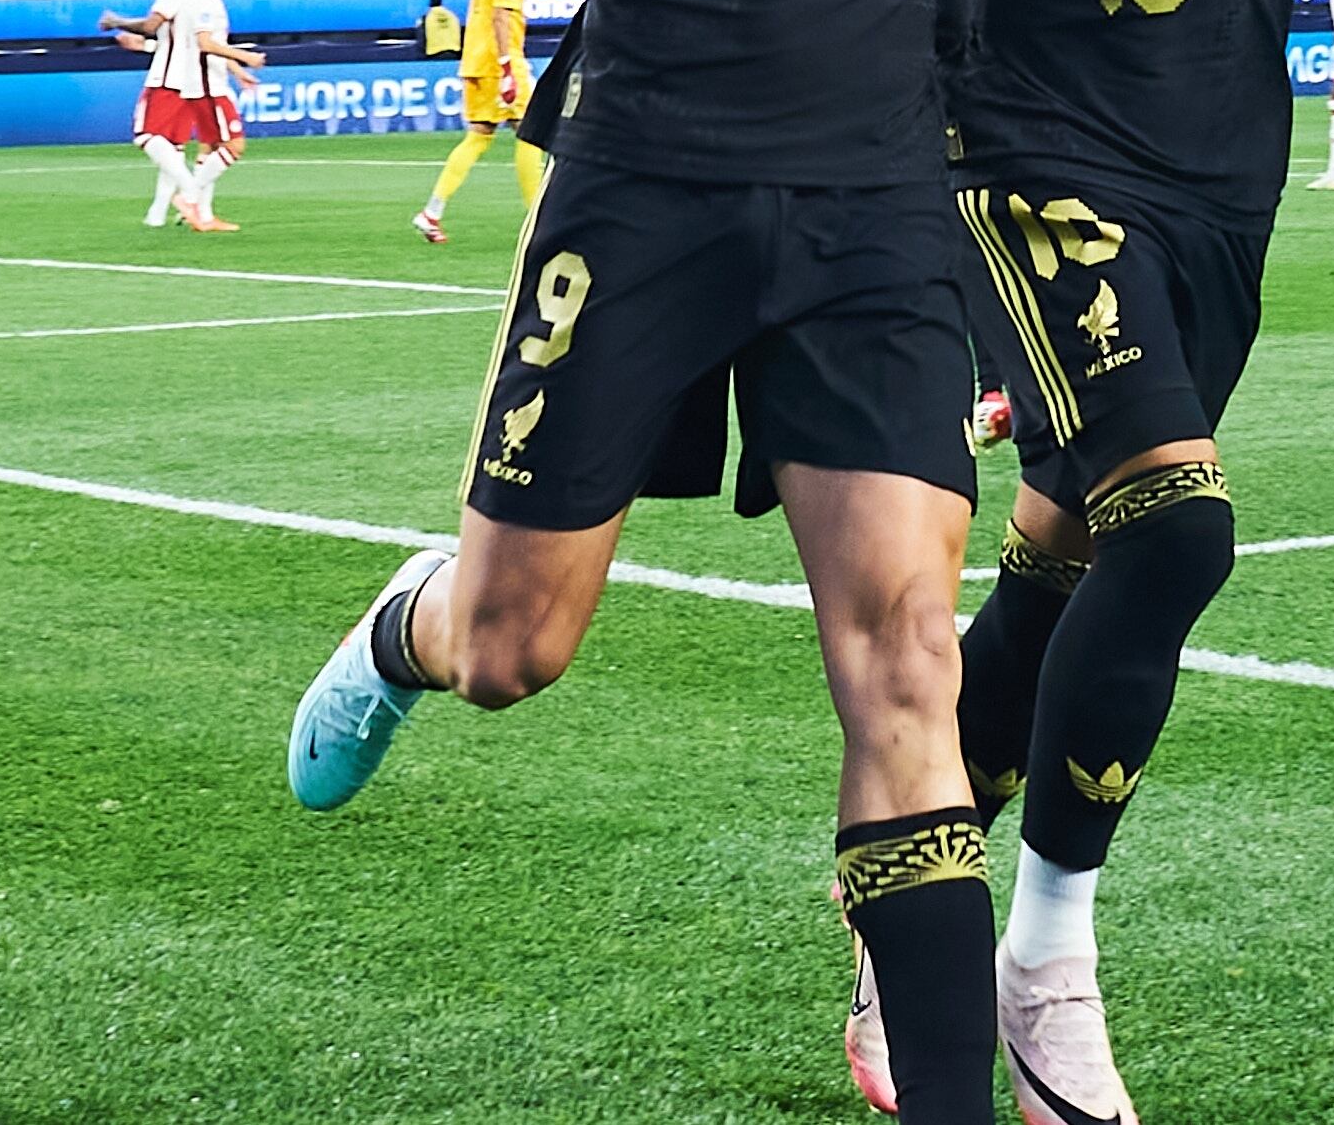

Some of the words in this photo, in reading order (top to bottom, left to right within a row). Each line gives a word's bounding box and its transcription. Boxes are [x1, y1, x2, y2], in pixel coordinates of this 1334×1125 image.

[371, 79, 428, 118] DE
[1008, 193, 1125, 281] 10
[518, 250, 592, 368] 9
